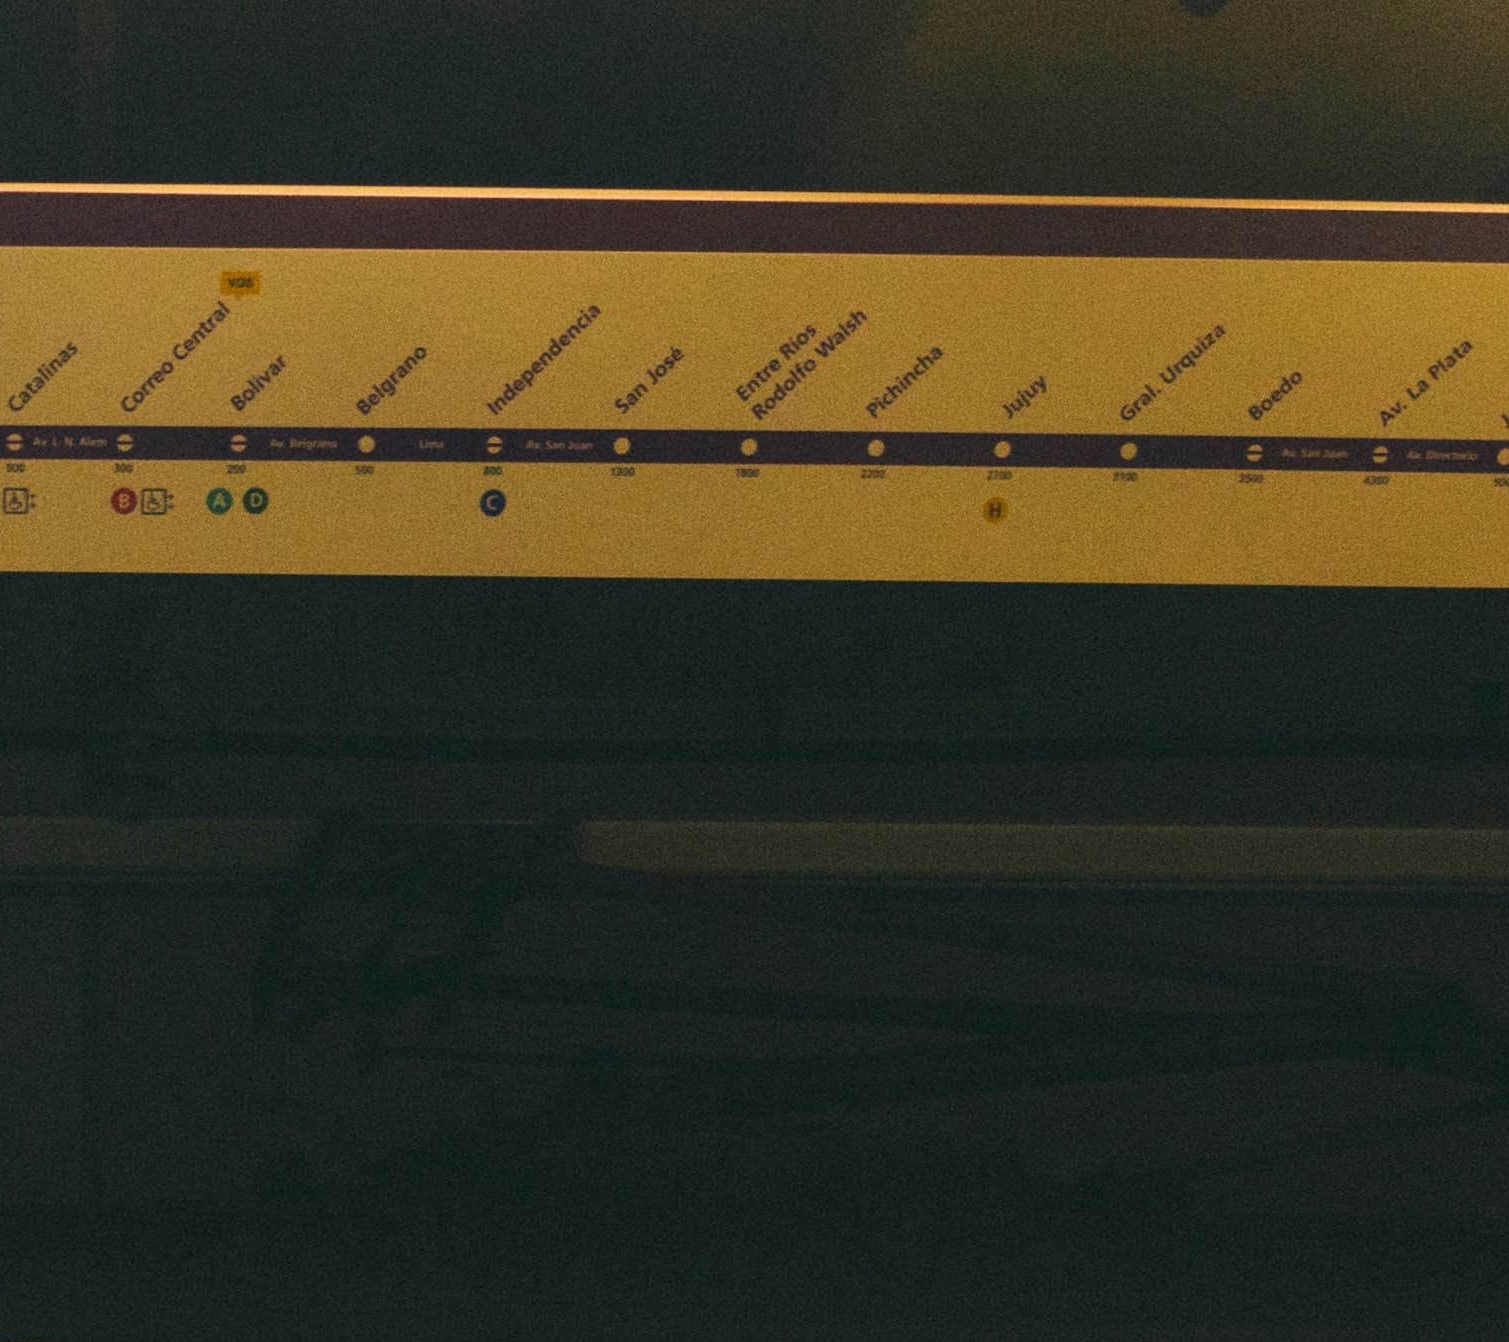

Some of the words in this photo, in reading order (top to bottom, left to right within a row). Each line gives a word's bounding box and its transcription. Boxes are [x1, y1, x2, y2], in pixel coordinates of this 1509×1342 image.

[8, 342, 78, 412] Catalinas
[120, 360, 174, 413] Correo
[172, 301, 231, 360] Central
[356, 346, 427, 416] Belgrano
[487, 303, 602, 416] Independencia
[614, 381, 648, 415] San
[647, 346, 685, 385] José
[736, 357, 782, 402] Entre
[750, 357, 817, 420] Rodolfo
[813, 309, 868, 359] Walsh
[865, 346, 944, 418] Pichincha
[1119, 384, 1163, 421] Gral.
[1159, 324, 1226, 387] Urquiza
[1380, 400, 1408, 427] Av.
[1406, 379, 1430, 401] La
[1427, 338, 1474, 381] Plata
[1002, 375, 1048, 420] Jujuy
[1247, 370, 1303, 421] Boedo
